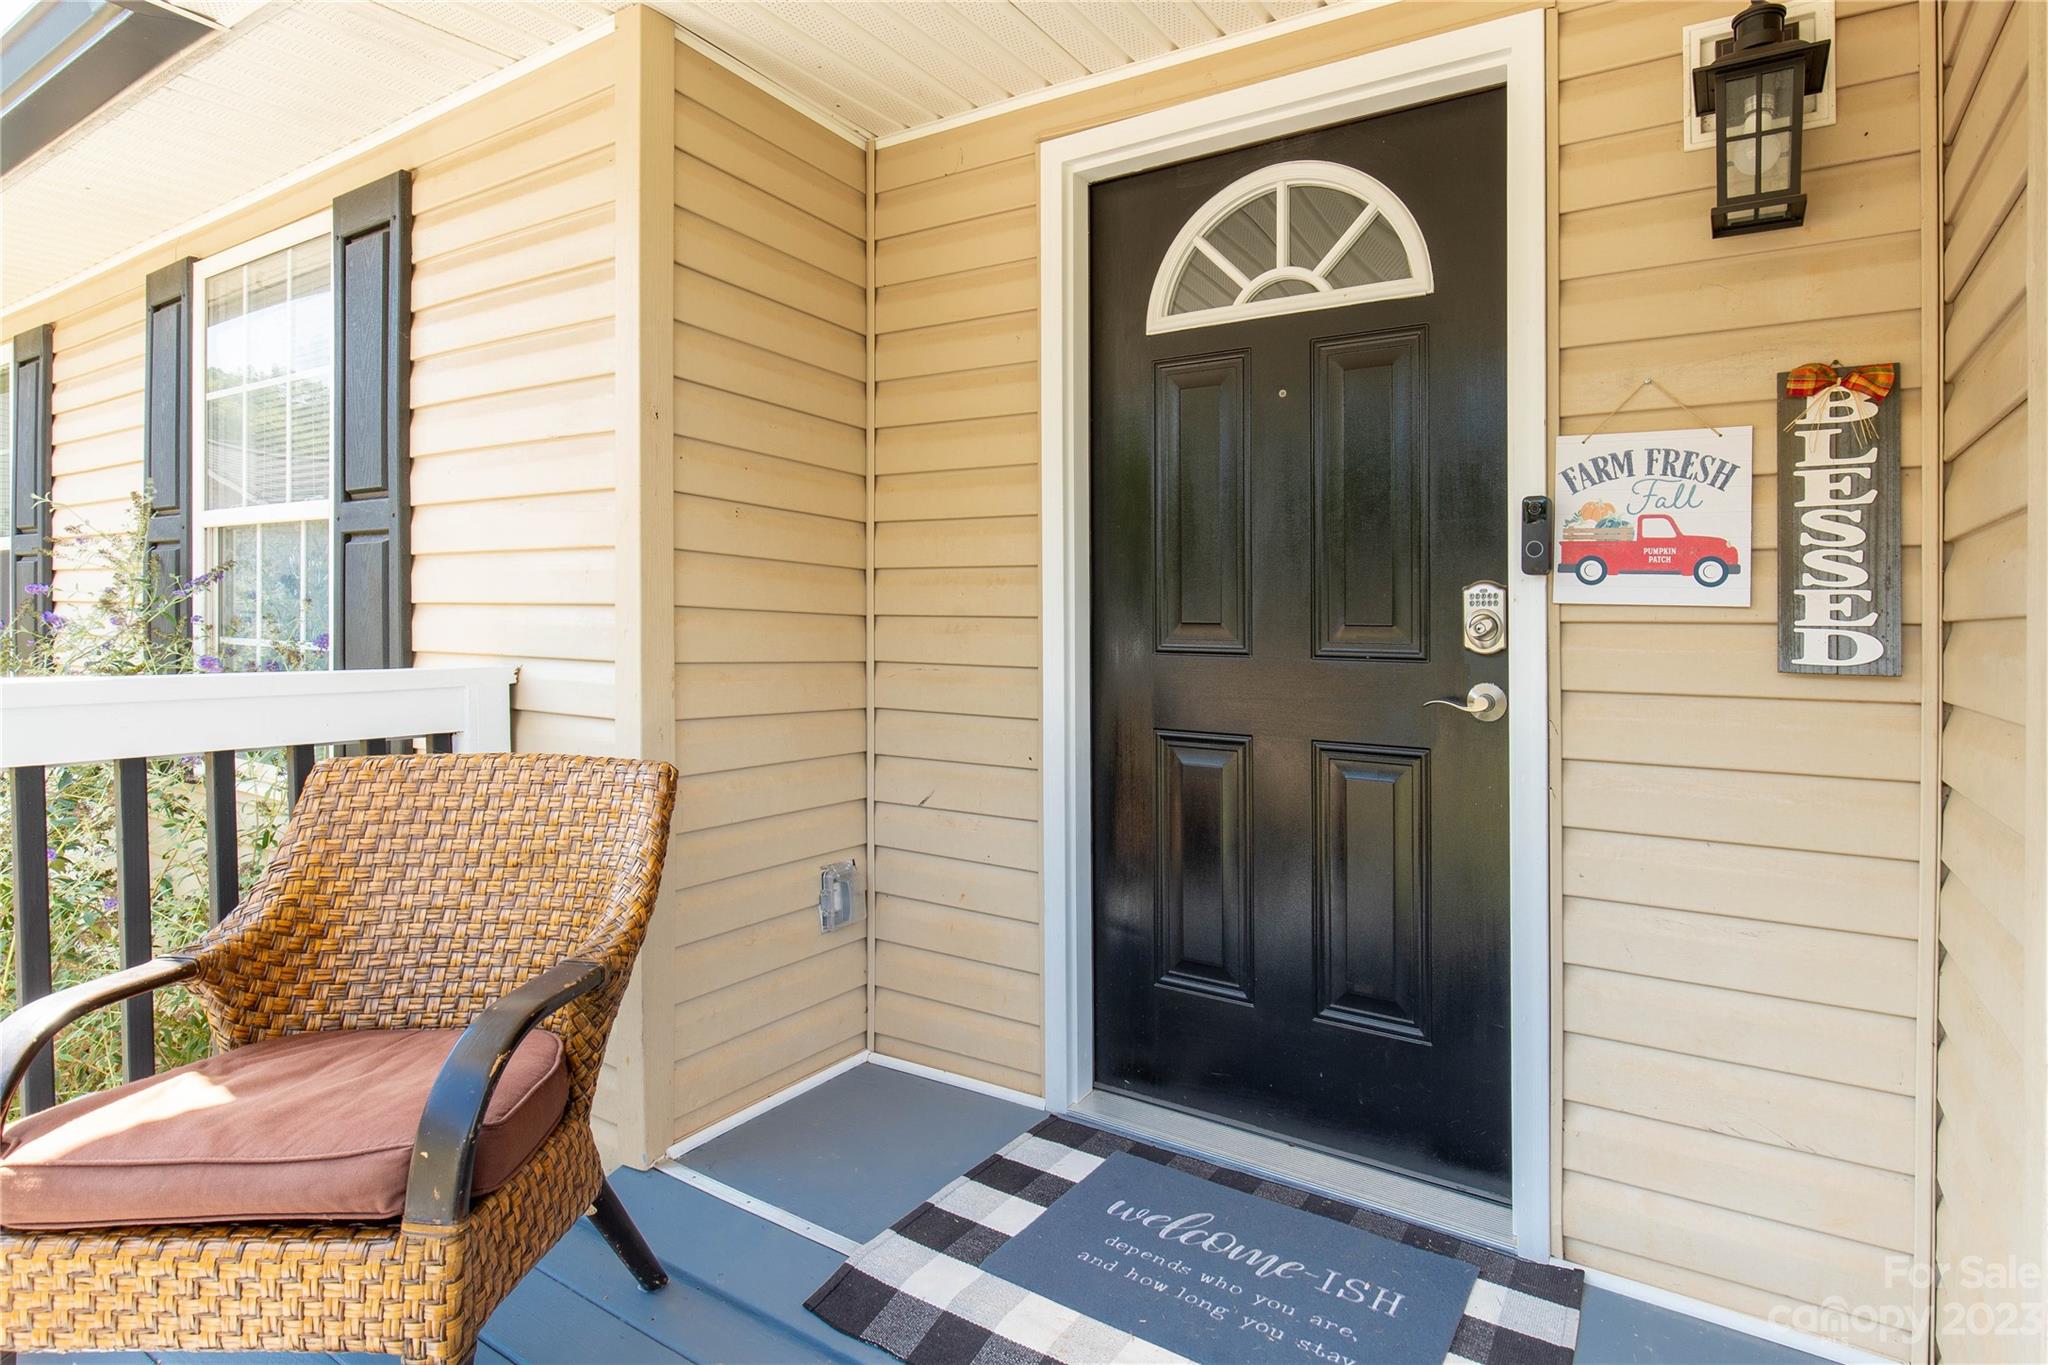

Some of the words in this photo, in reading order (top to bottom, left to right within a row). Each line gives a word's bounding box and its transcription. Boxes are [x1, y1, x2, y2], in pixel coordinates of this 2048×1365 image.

[1558, 449, 1635, 496] FARM
[1644, 447, 1742, 493] FRESH
[1626, 478, 1704, 516] Fall
[1791, 385, 1885, 667] BLESSED
[1643, 546, 1677, 556] PUMPKIN
[1648, 555, 1672, 564] PATCH
[1077, 1251, 1117, 1273] and
[1126, 1266, 1168, 1293] how
[1174, 1285, 1231, 1321] long
[1240, 1315, 1285, 1342] you
[1104, 1236, 1192, 1276] depends
[1200, 1272, 1244, 1295] who
[1252, 1294, 1296, 1317] you
[1309, 1315, 1358, 1342] are,
